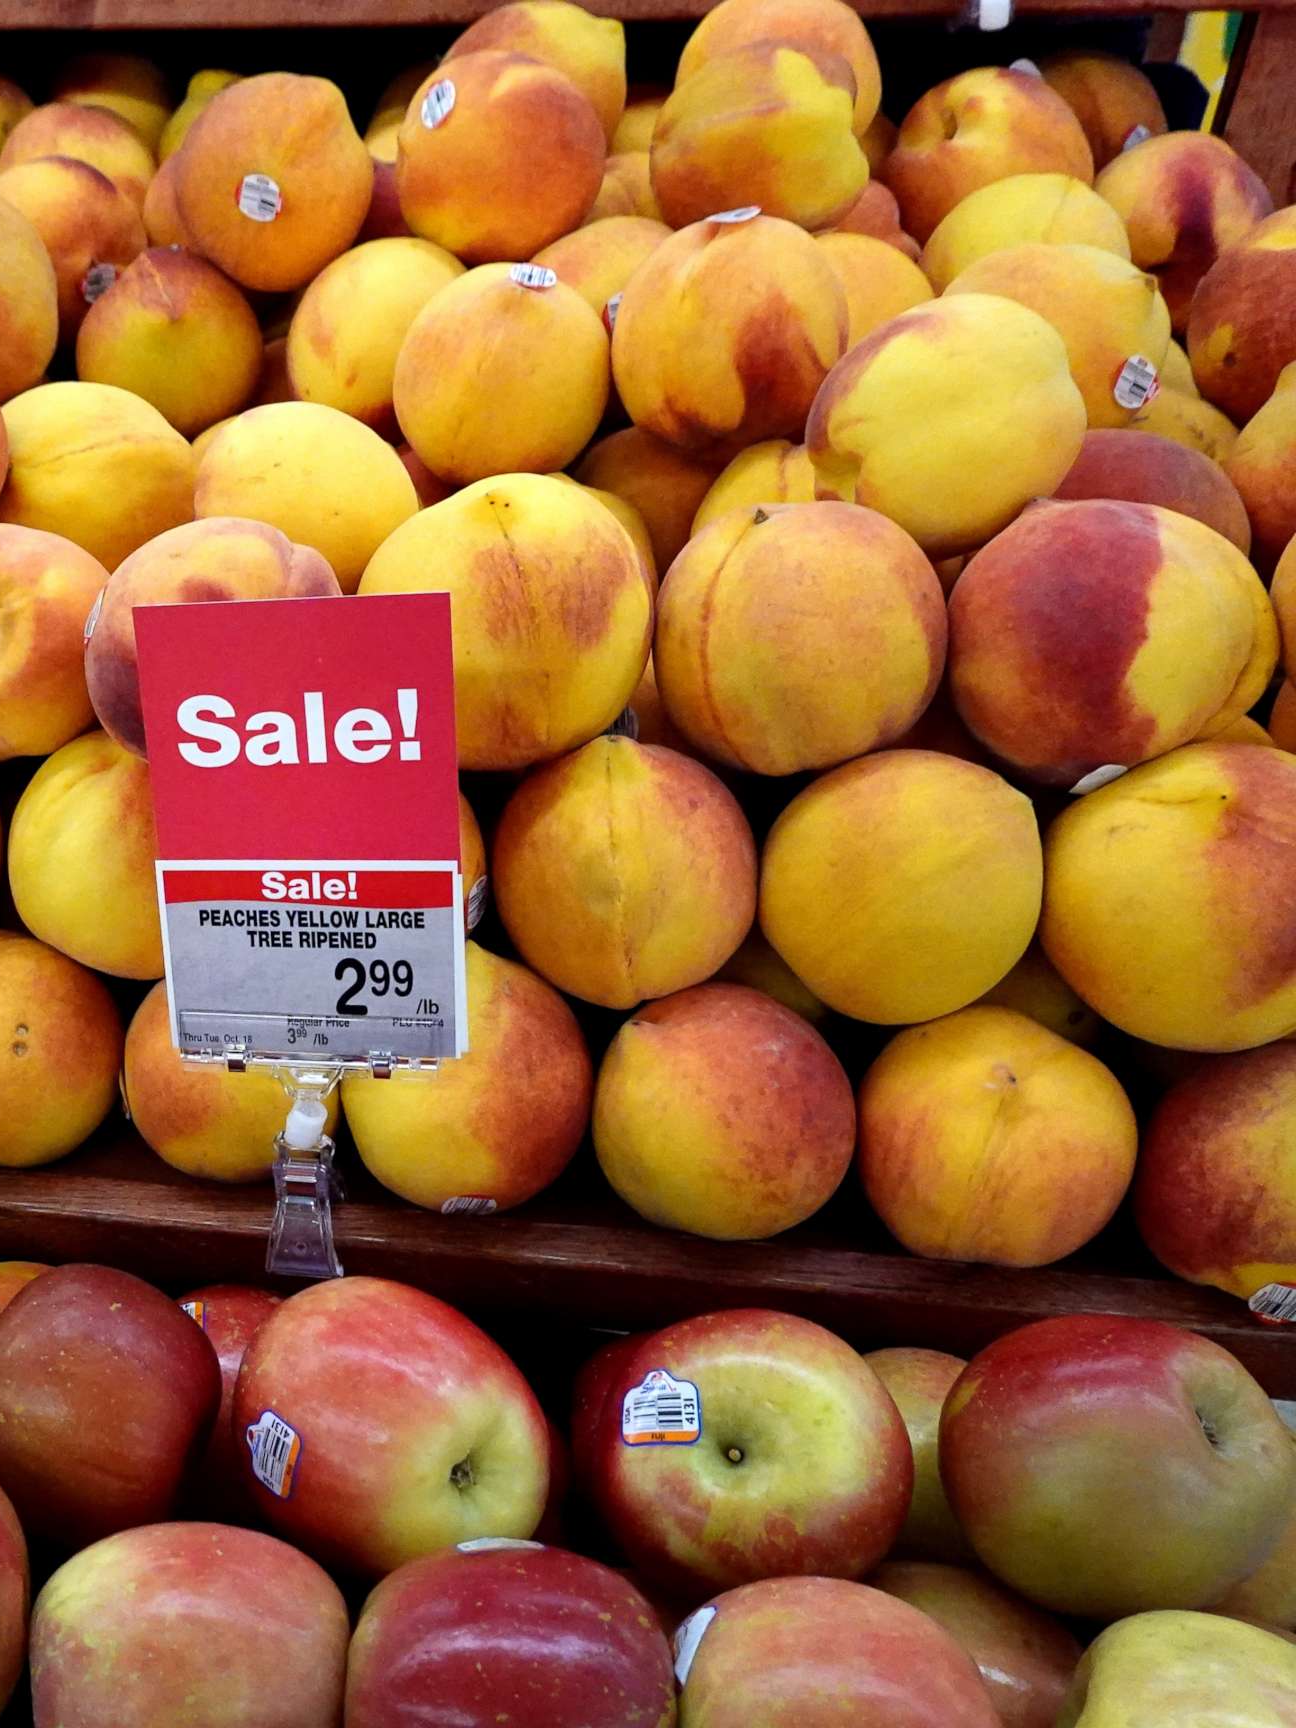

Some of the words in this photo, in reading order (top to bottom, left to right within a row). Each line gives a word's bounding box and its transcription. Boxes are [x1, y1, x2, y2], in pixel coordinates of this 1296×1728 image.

[176, 688, 422, 769] Sale!
[260, 871, 359, 900] Sale!
[199, 909, 281, 927] PEACHES
[286, 910, 360, 928] YELLOW
[365, 910, 425, 929] LARGE
[247, 930, 293, 948] TREE
[299, 931, 377, 949] RIPENED
[416, 998, 440, 1015] /lb
[287, 1014, 322, 1029] Regular
[325, 1015, 350, 1028] Price
[392, 1016, 413, 1028] PLU
[183, 1032, 202, 1042] Thru
[313, 1033, 329, 1046] /lb
[683, 1398, 696, 1425] 4131
[271, 1418, 291, 1439] 4131
